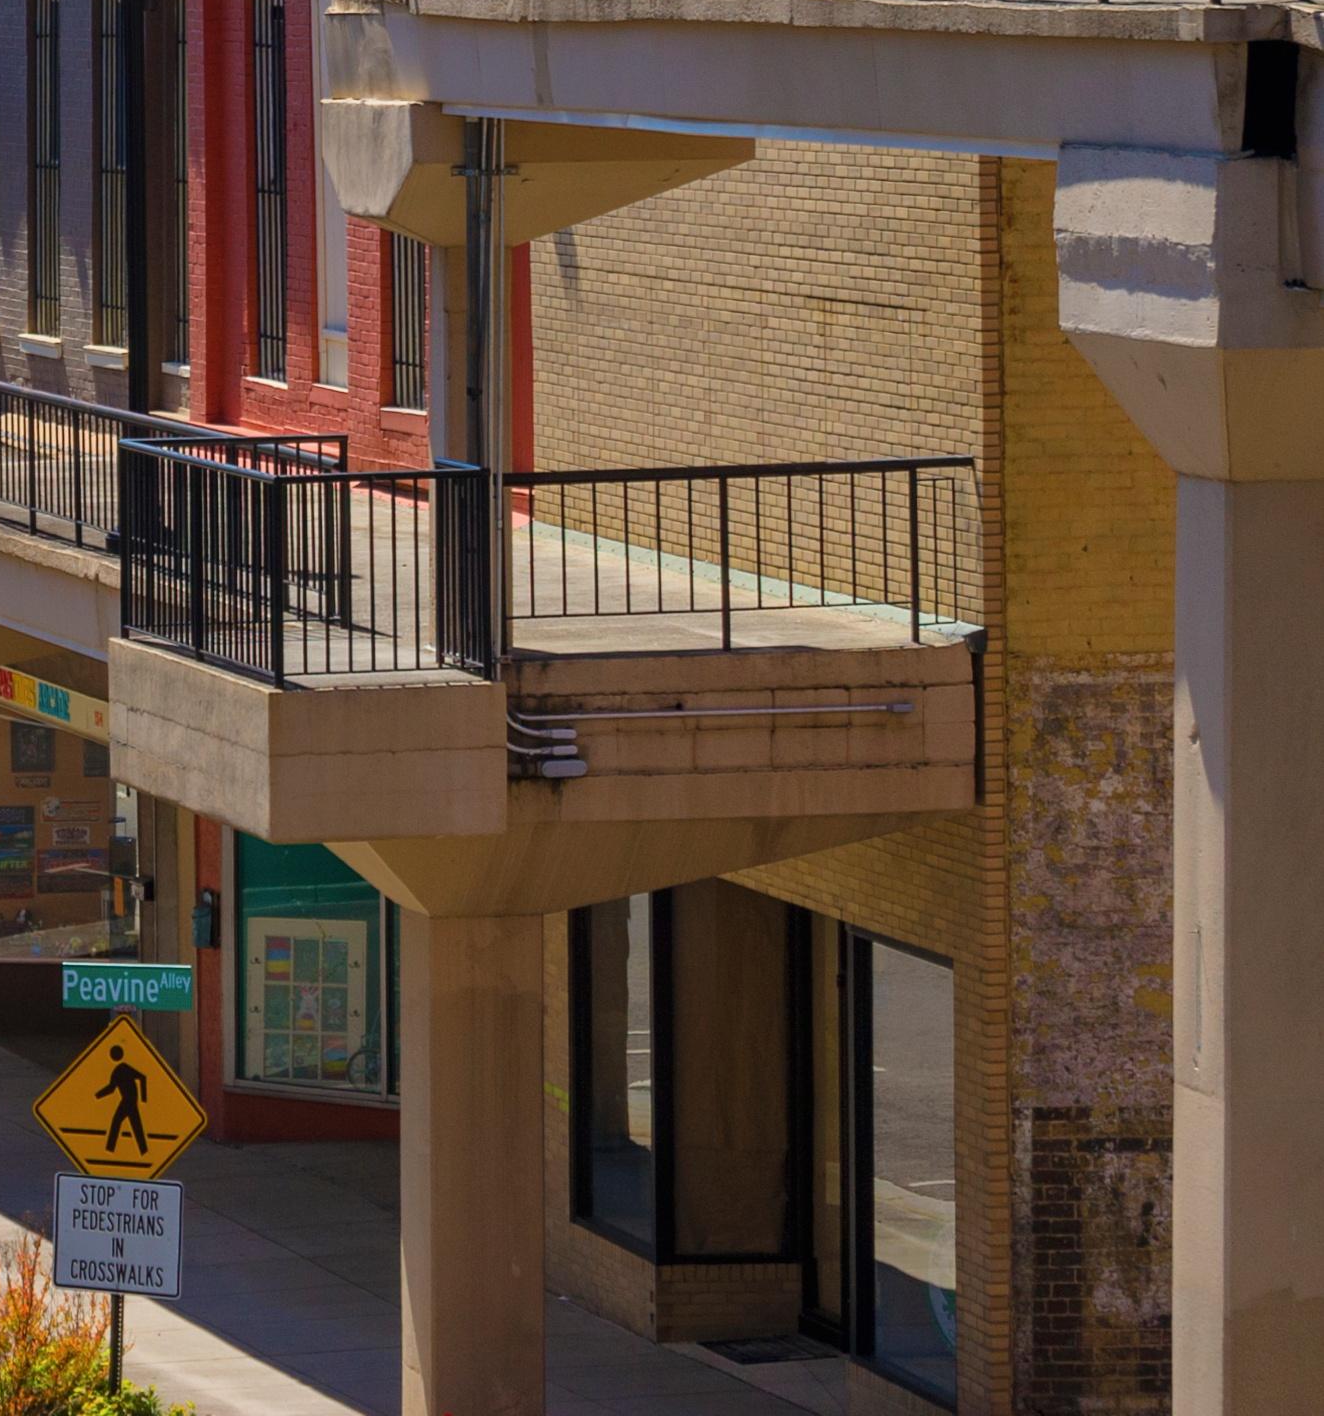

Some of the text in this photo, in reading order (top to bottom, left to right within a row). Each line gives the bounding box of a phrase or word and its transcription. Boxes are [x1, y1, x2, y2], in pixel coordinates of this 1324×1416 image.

[63, 970, 191, 1003] Peavine Alley
[79, 1184, 159, 1211] STOP FOR
[72, 1209, 164, 1237] PEDESTRIANS
[112, 1237, 124, 1258] IN
[70, 1259, 164, 1288] CROSSWALKS
